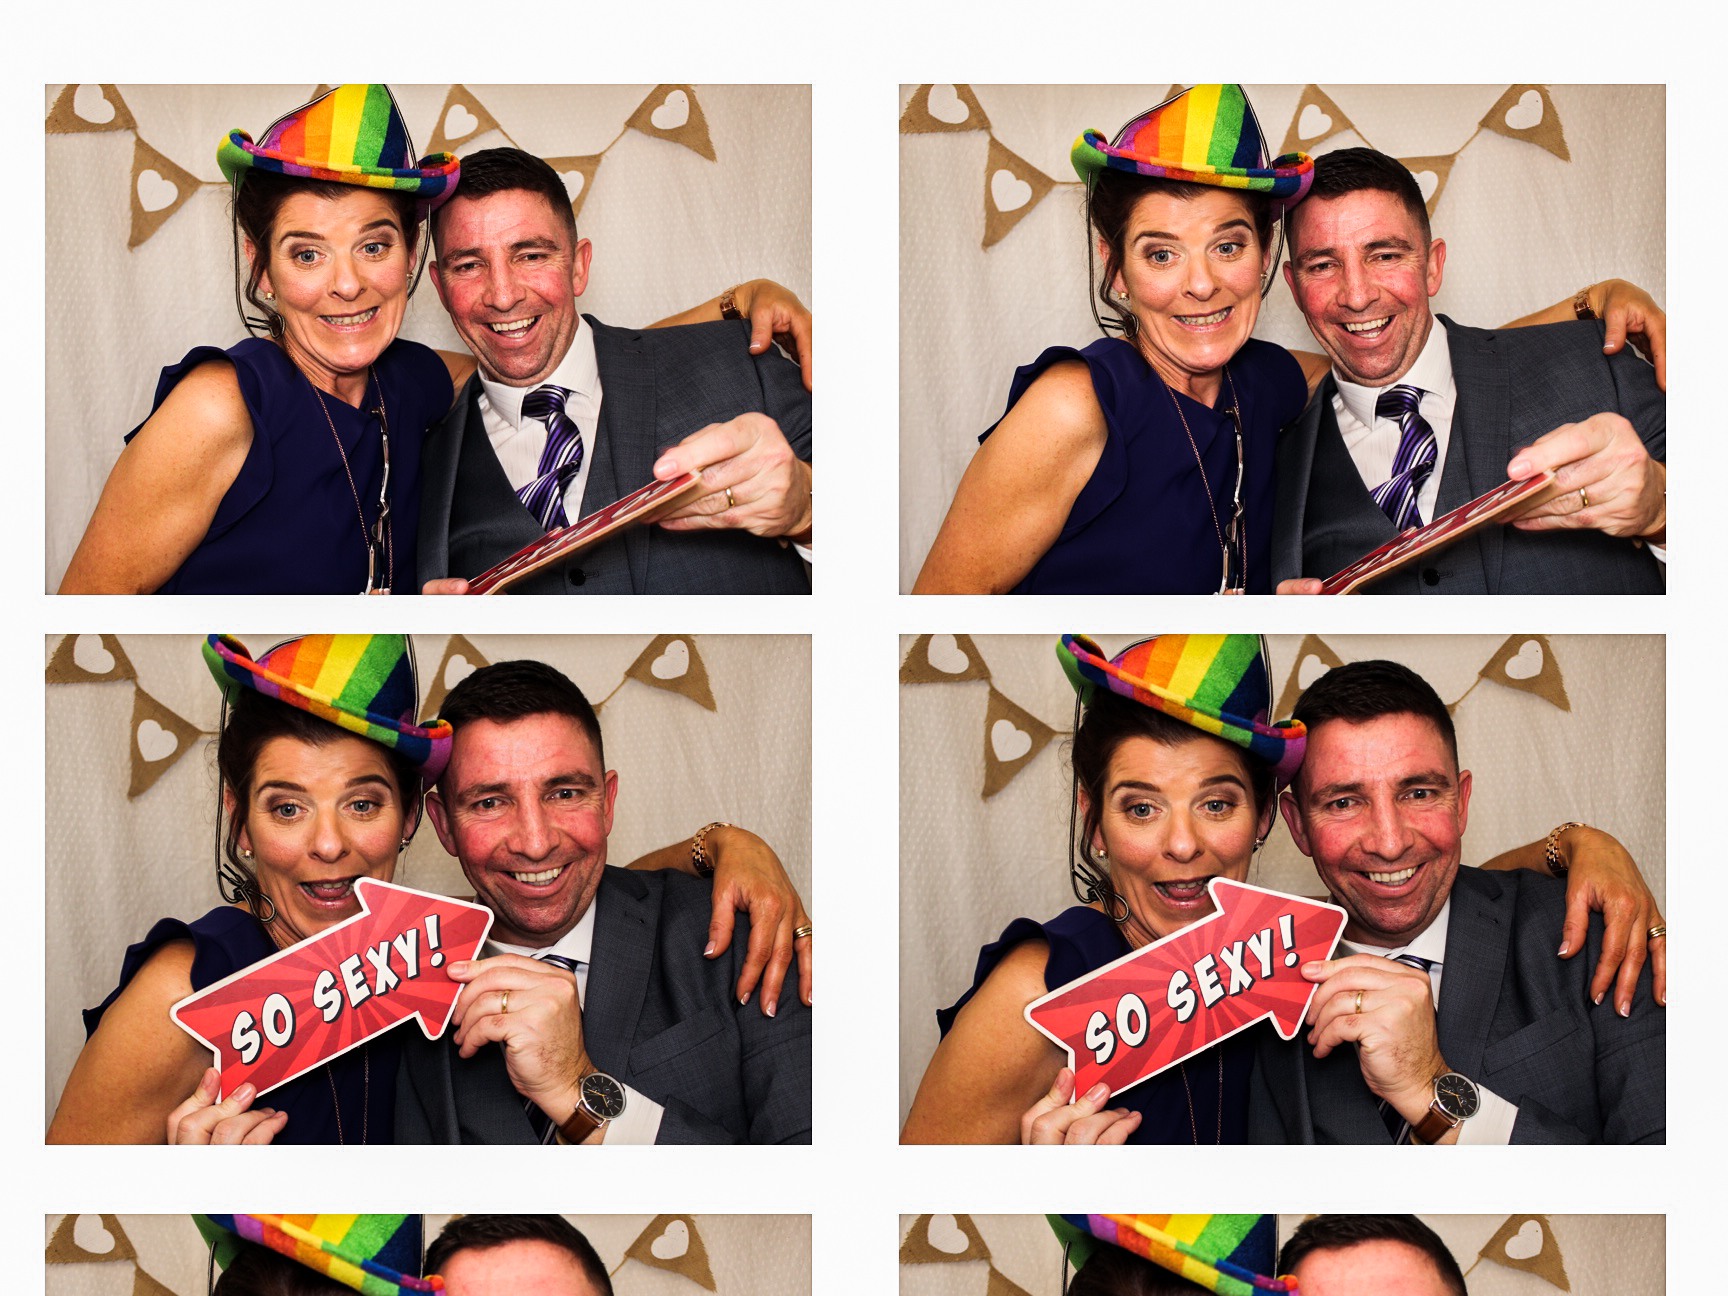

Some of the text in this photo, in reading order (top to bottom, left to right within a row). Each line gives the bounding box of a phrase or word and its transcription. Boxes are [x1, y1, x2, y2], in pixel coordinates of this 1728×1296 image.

[230, 913, 445, 1065] SO SEXY!
[1084, 913, 1299, 1065] SO SEXY!
